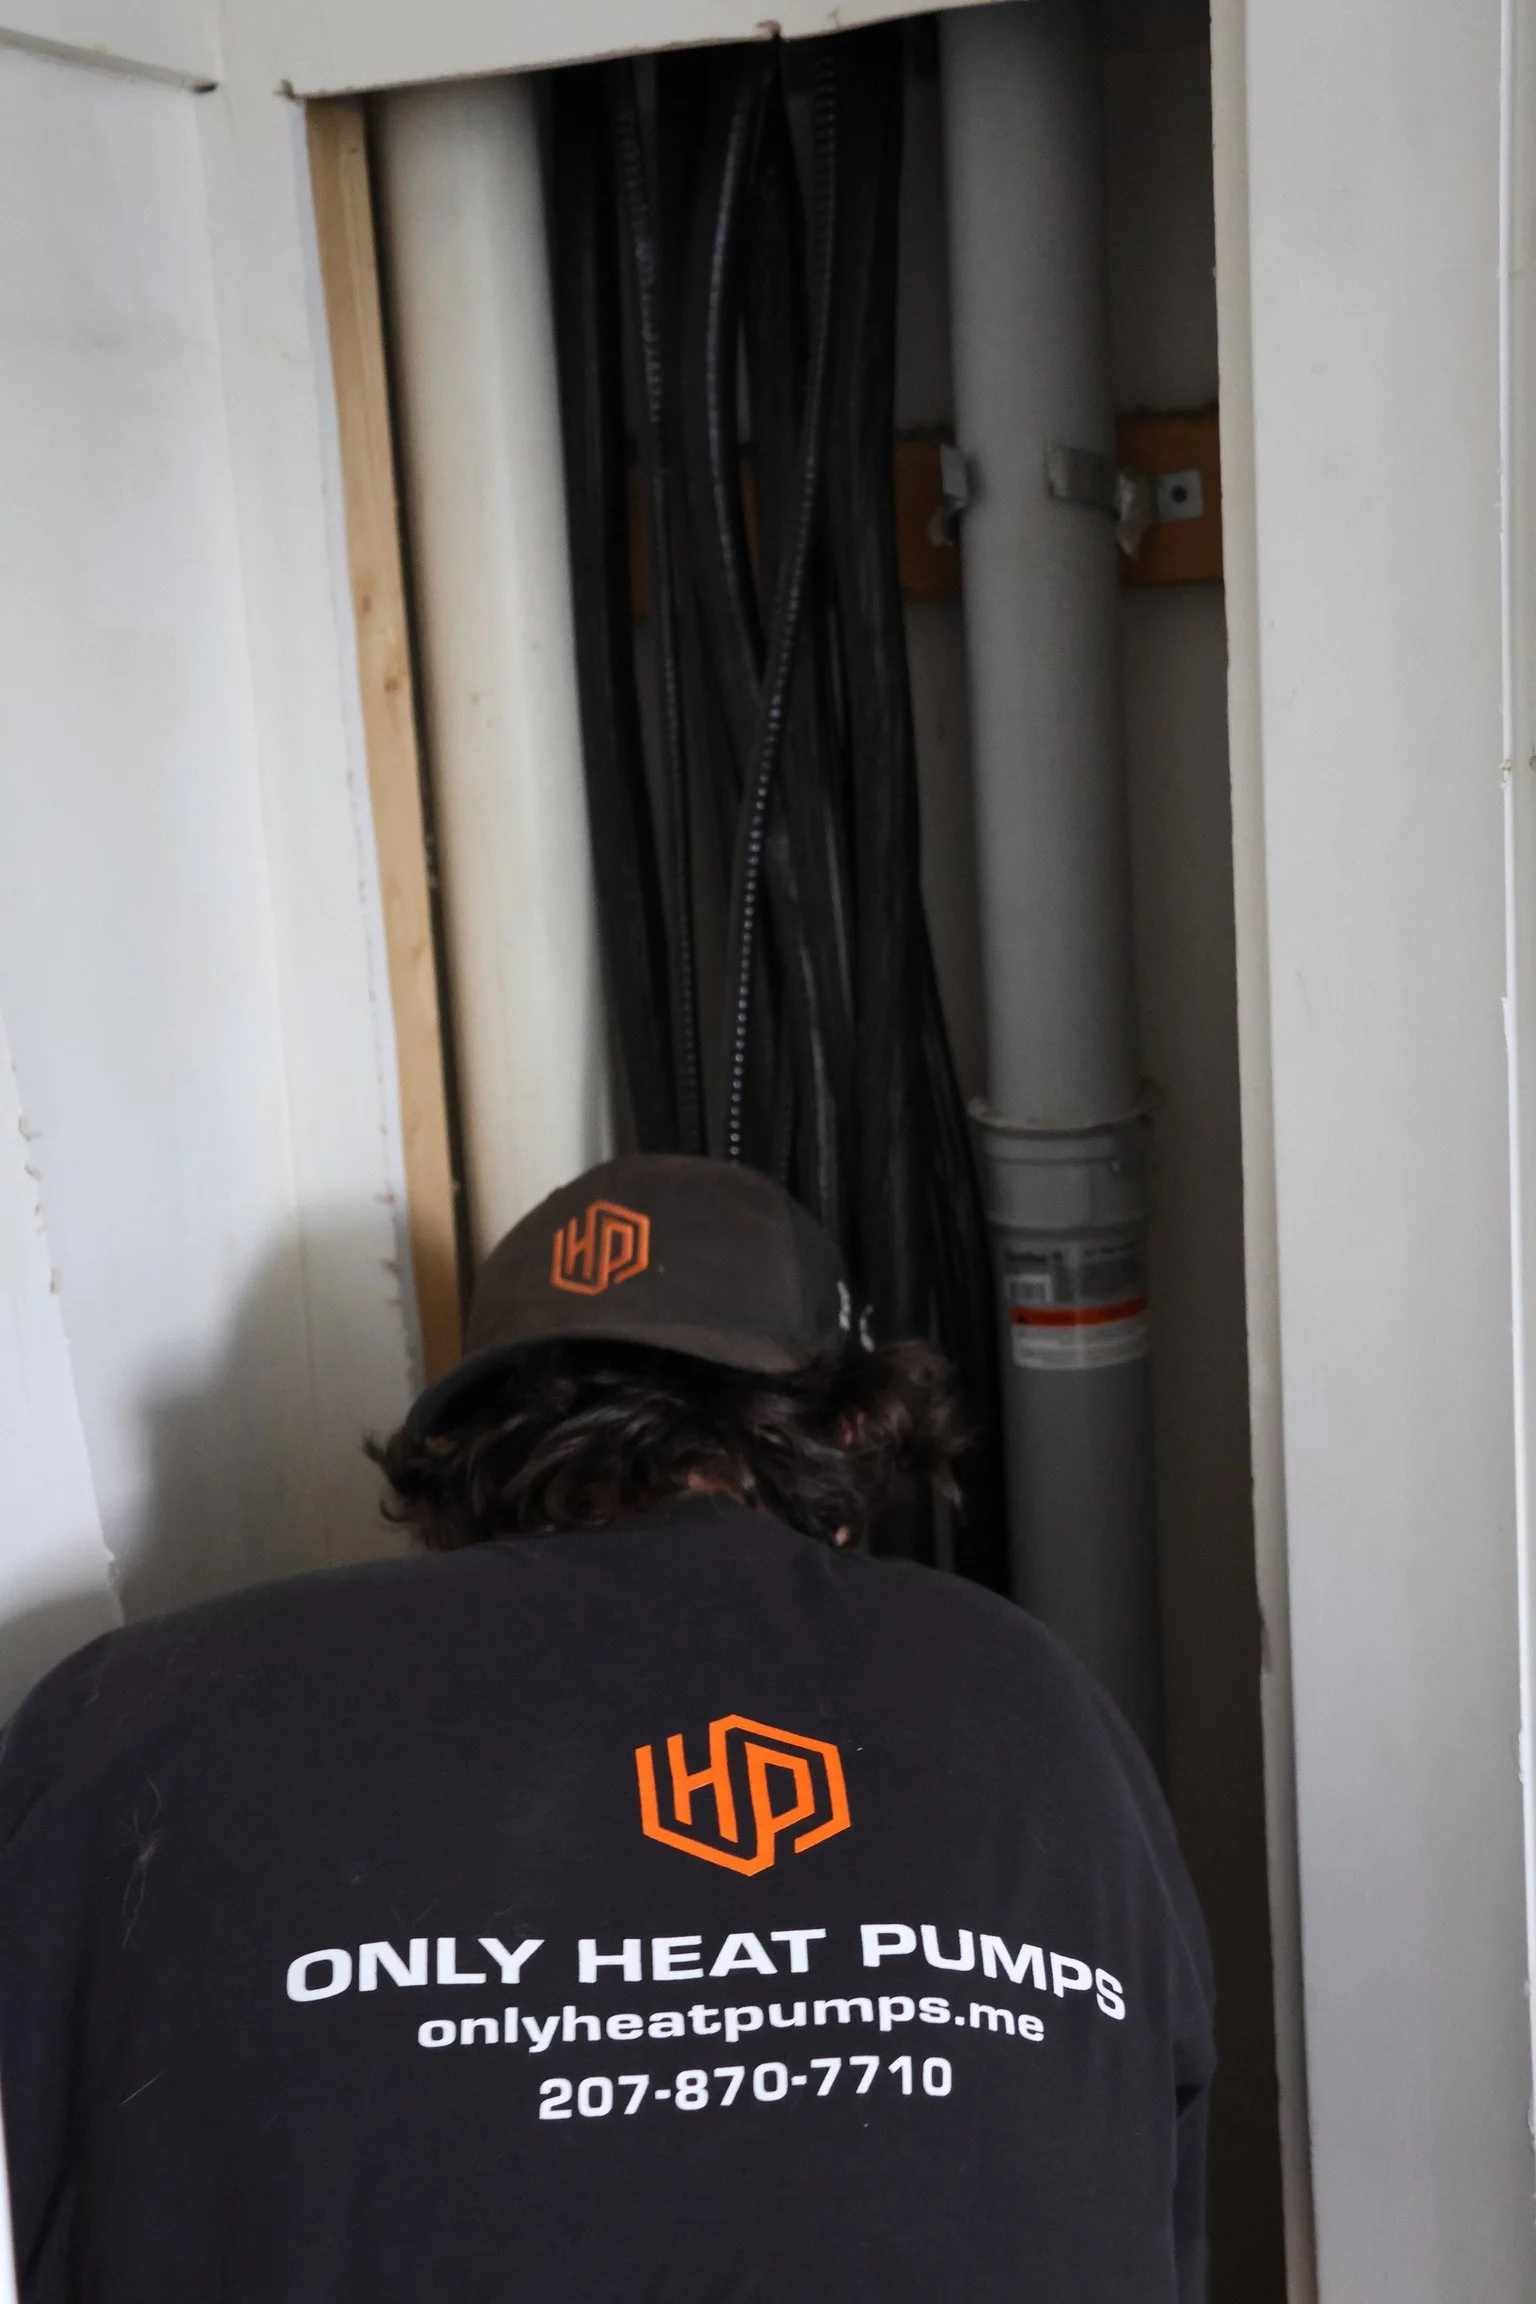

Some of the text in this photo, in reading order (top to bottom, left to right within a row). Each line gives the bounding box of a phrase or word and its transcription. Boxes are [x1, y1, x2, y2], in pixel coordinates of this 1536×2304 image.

[286, 1923, 1126, 2021] ONLY HEAT PUMPS
[417, 1995, 1045, 2055] onlyheatpumps.me
[538, 2055, 952, 2120] 207-870-7710
